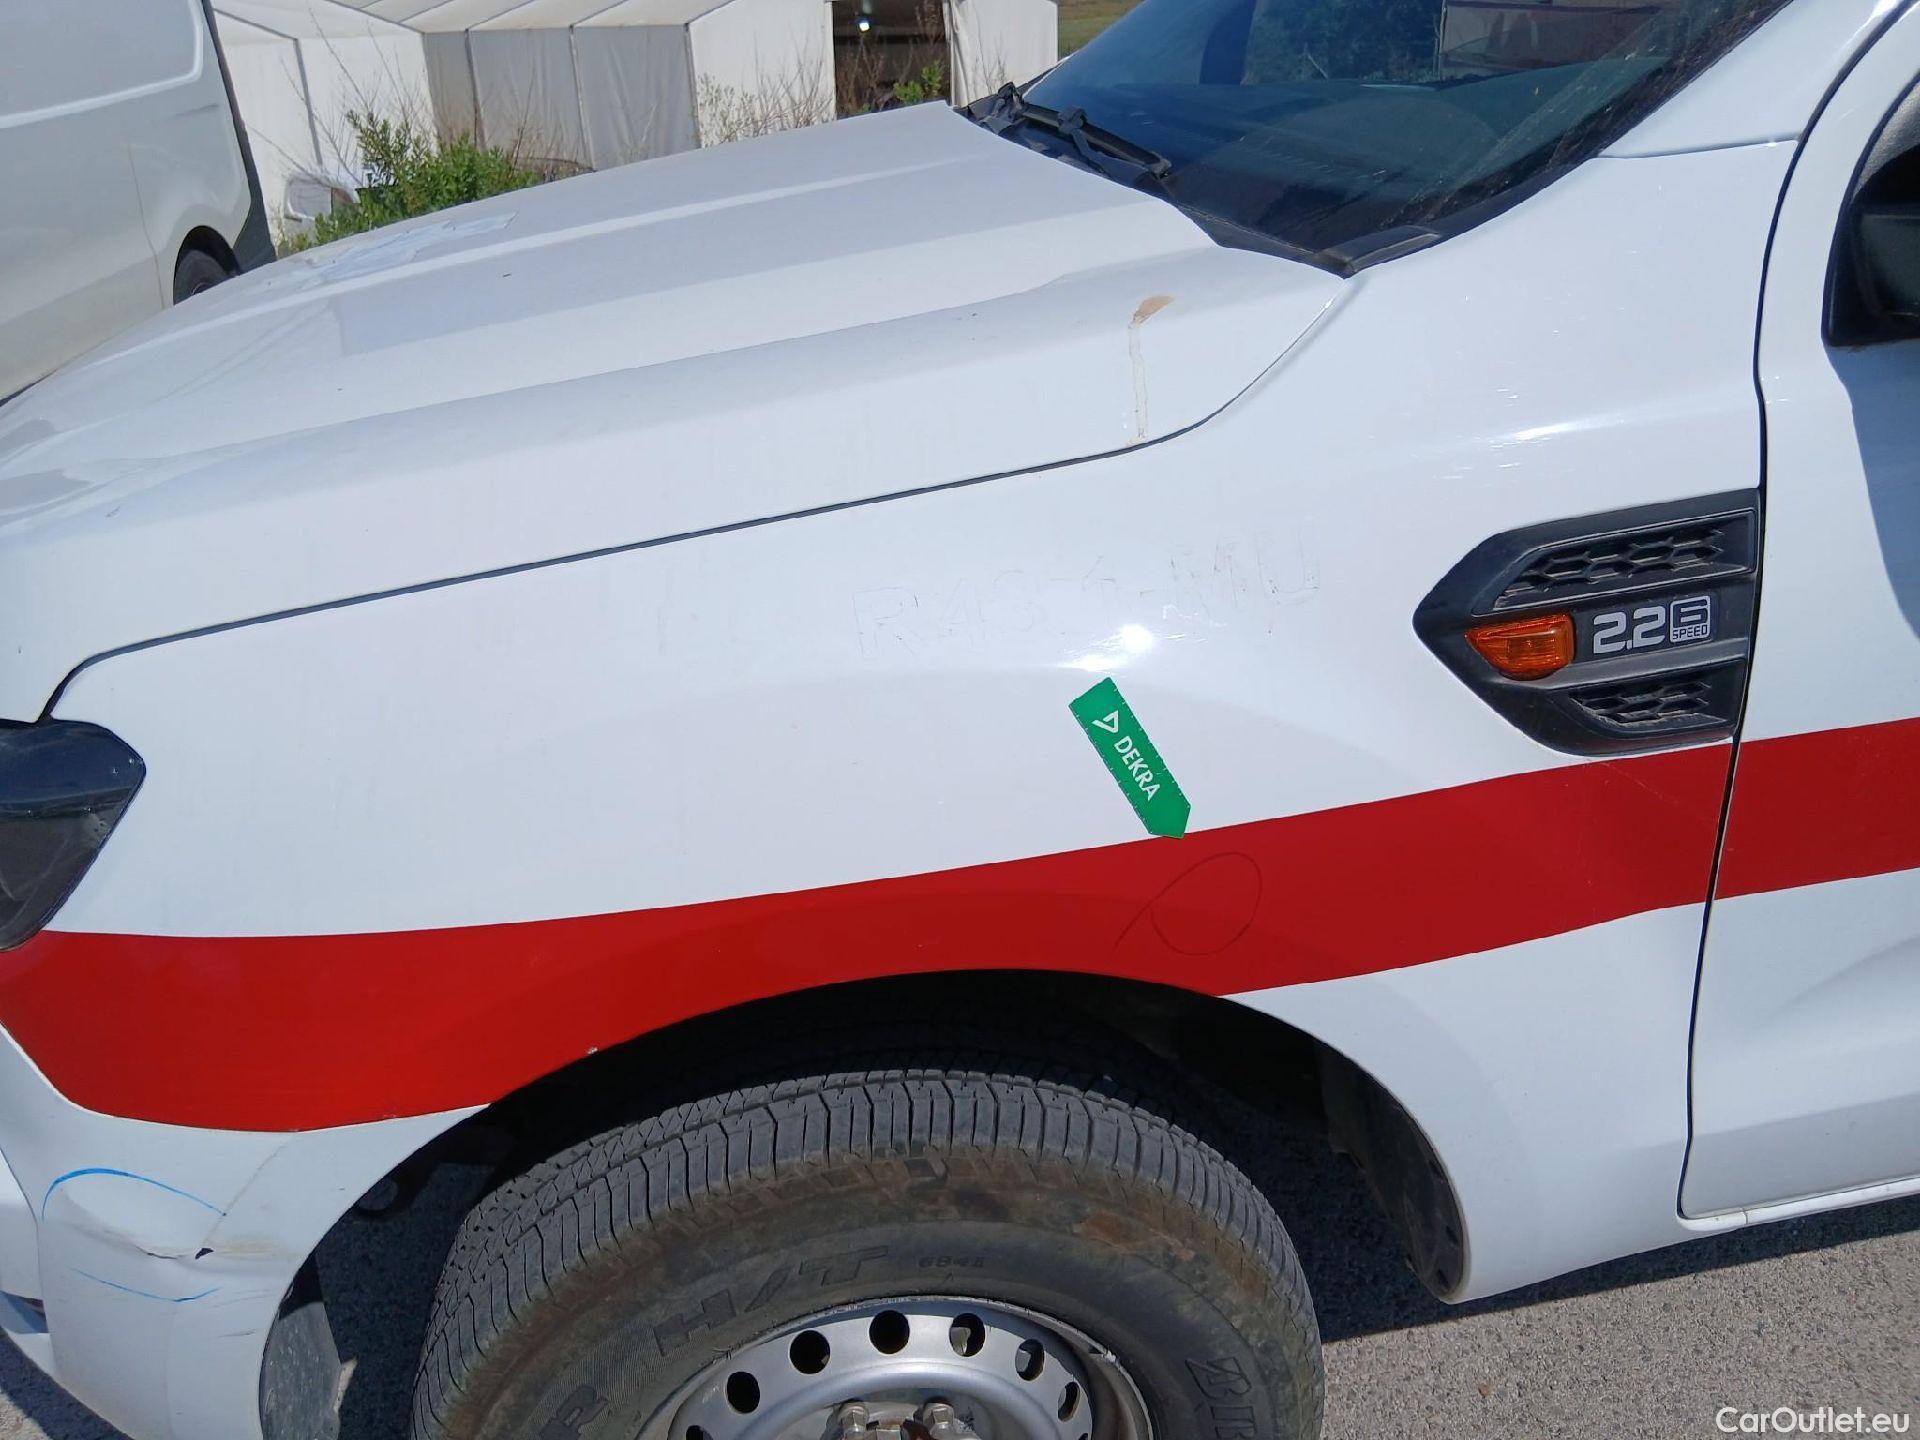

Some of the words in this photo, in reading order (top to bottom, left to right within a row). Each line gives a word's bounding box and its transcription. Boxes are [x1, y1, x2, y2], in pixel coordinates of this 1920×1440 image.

[1593, 606, 1666, 654] 2.2
[1672, 624, 1708, 640] SPEED
[1113, 735, 1160, 801] DEKRA
